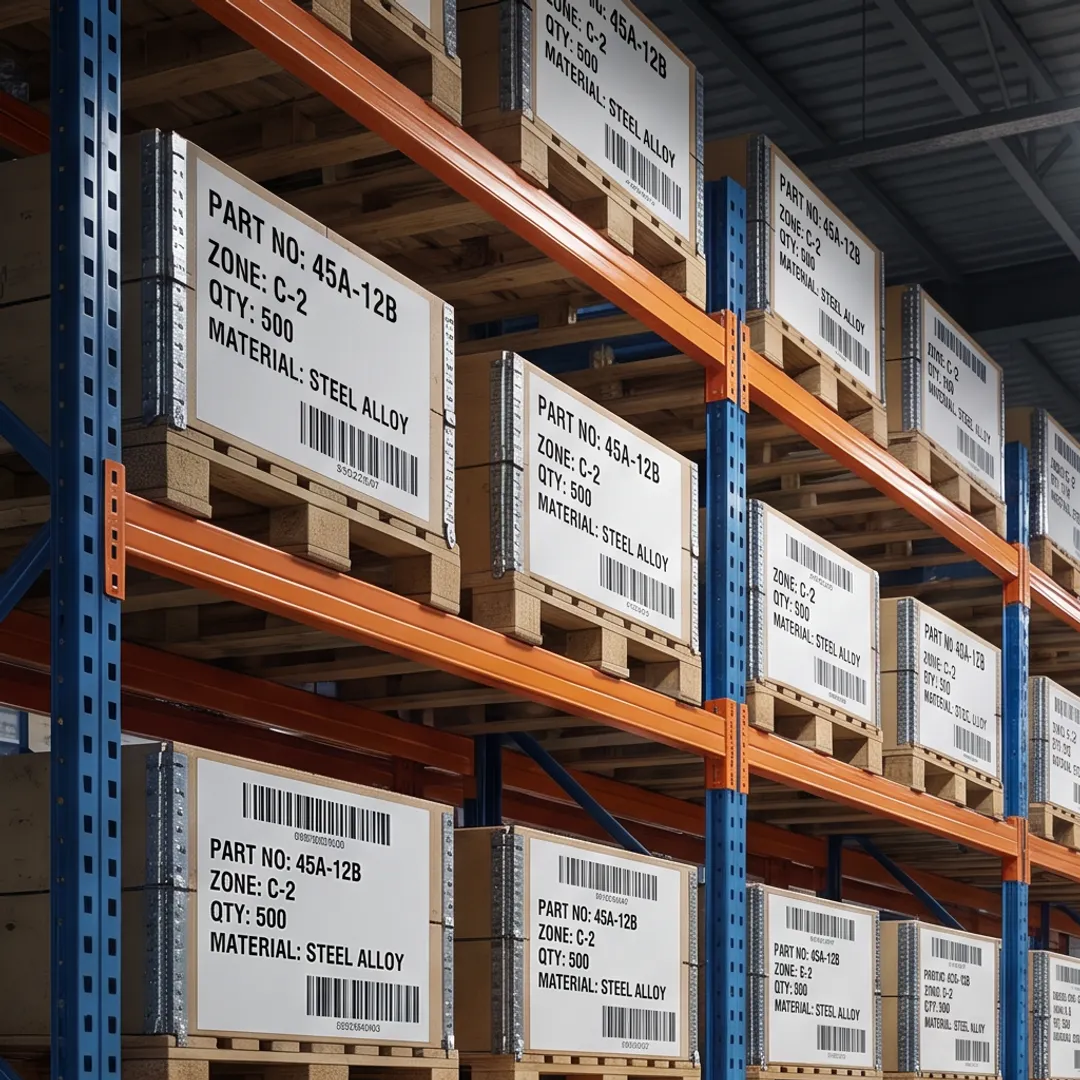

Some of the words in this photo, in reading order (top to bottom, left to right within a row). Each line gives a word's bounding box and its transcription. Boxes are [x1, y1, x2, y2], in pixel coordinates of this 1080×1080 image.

[546, 14, 573, 53] QTY:
[577, 41, 598, 73] 500
[586, 21, 606, 55] C-2
[610, 11, 666, 79] 45A-12B
[545, 40, 606, 109] MATERIAL:
[609, 98, 641, 140] STEEL
[643, 129, 675, 168] ALLOY
[779, 203, 804, 238] ZONE:
[806, 229, 821, 256] C-2
[780, 173, 804, 209] PART
[806, 199, 821, 229] NO:
[823, 218, 860, 265] 45A-12B
[209, 189, 265, 244] PART
[272, 227, 305, 270] NO:
[312, 254, 397, 323] 45A-12B
[780, 228, 799, 257] QTY:
[208, 238, 266, 293] ZONE:
[274, 276, 307, 316] C-2
[209, 279, 254, 324] QTY:
[261, 307, 293, 343] 500
[843, 308, 865, 335] ALLOY
[209, 316, 303, 384] MATERIAL:
[310, 368, 357, 411] STEEL
[362, 396, 408, 435] ALLOY
[538, 394, 574, 433] PART
[578, 418, 600, 450] NO:
[605, 436, 660, 484] 45A-12B
[538, 433, 574, 471] ZONE:
[579, 457, 600, 485] C-2
[538, 464, 566, 495] QTY:
[571, 481, 591, 507] 500
[538, 492, 598, 538] MATERIAL:
[602, 525, 634, 556] STEEL
[637, 544, 668, 572] ALLOY
[773, 567, 797, 594] ZONE:
[773, 589, 793, 612] QTY:
[774, 612, 814, 645] MATERIAL:
[816, 634, 837, 657] STEEL
[839, 646, 861, 667] ALLOY
[925, 623, 942, 646] PART
[210, 838, 256, 865] PART
[262, 847, 291, 871] NO:
[296, 854, 361, 882] 45A-12B
[210, 869, 261, 896] ZONE:
[268, 878, 295, 901] C-2
[210, 900, 250, 925] QTY:
[256, 906, 286, 929] 500
[538, 899, 569, 919] PART
[572, 905, 591, 923] NO:
[594, 909, 637, 930] 45A-12B
[211, 932, 300, 961] MATERIAL:
[306, 942, 353, 966] STEEL
[357, 949, 404, 971] ALLOY
[538, 923, 573, 944] ZONE:
[576, 929, 595, 947] C-2
[774, 942, 794, 958] PART
[796, 946, 809, 960] NO:
[538, 947, 565, 967] QTY:
[569, 951, 589, 970] 500
[774, 962, 798, 977] ZONE:
[538, 972, 598, 993] MATERIAL:
[601, 979, 633, 997] STEEL
[634, 983, 666, 1000] ALLOY
[774, 980, 793, 995] QTY:
[775, 999, 814, 1015] MATERIAL:
[837, 1007, 860, 1021] ALLOY
